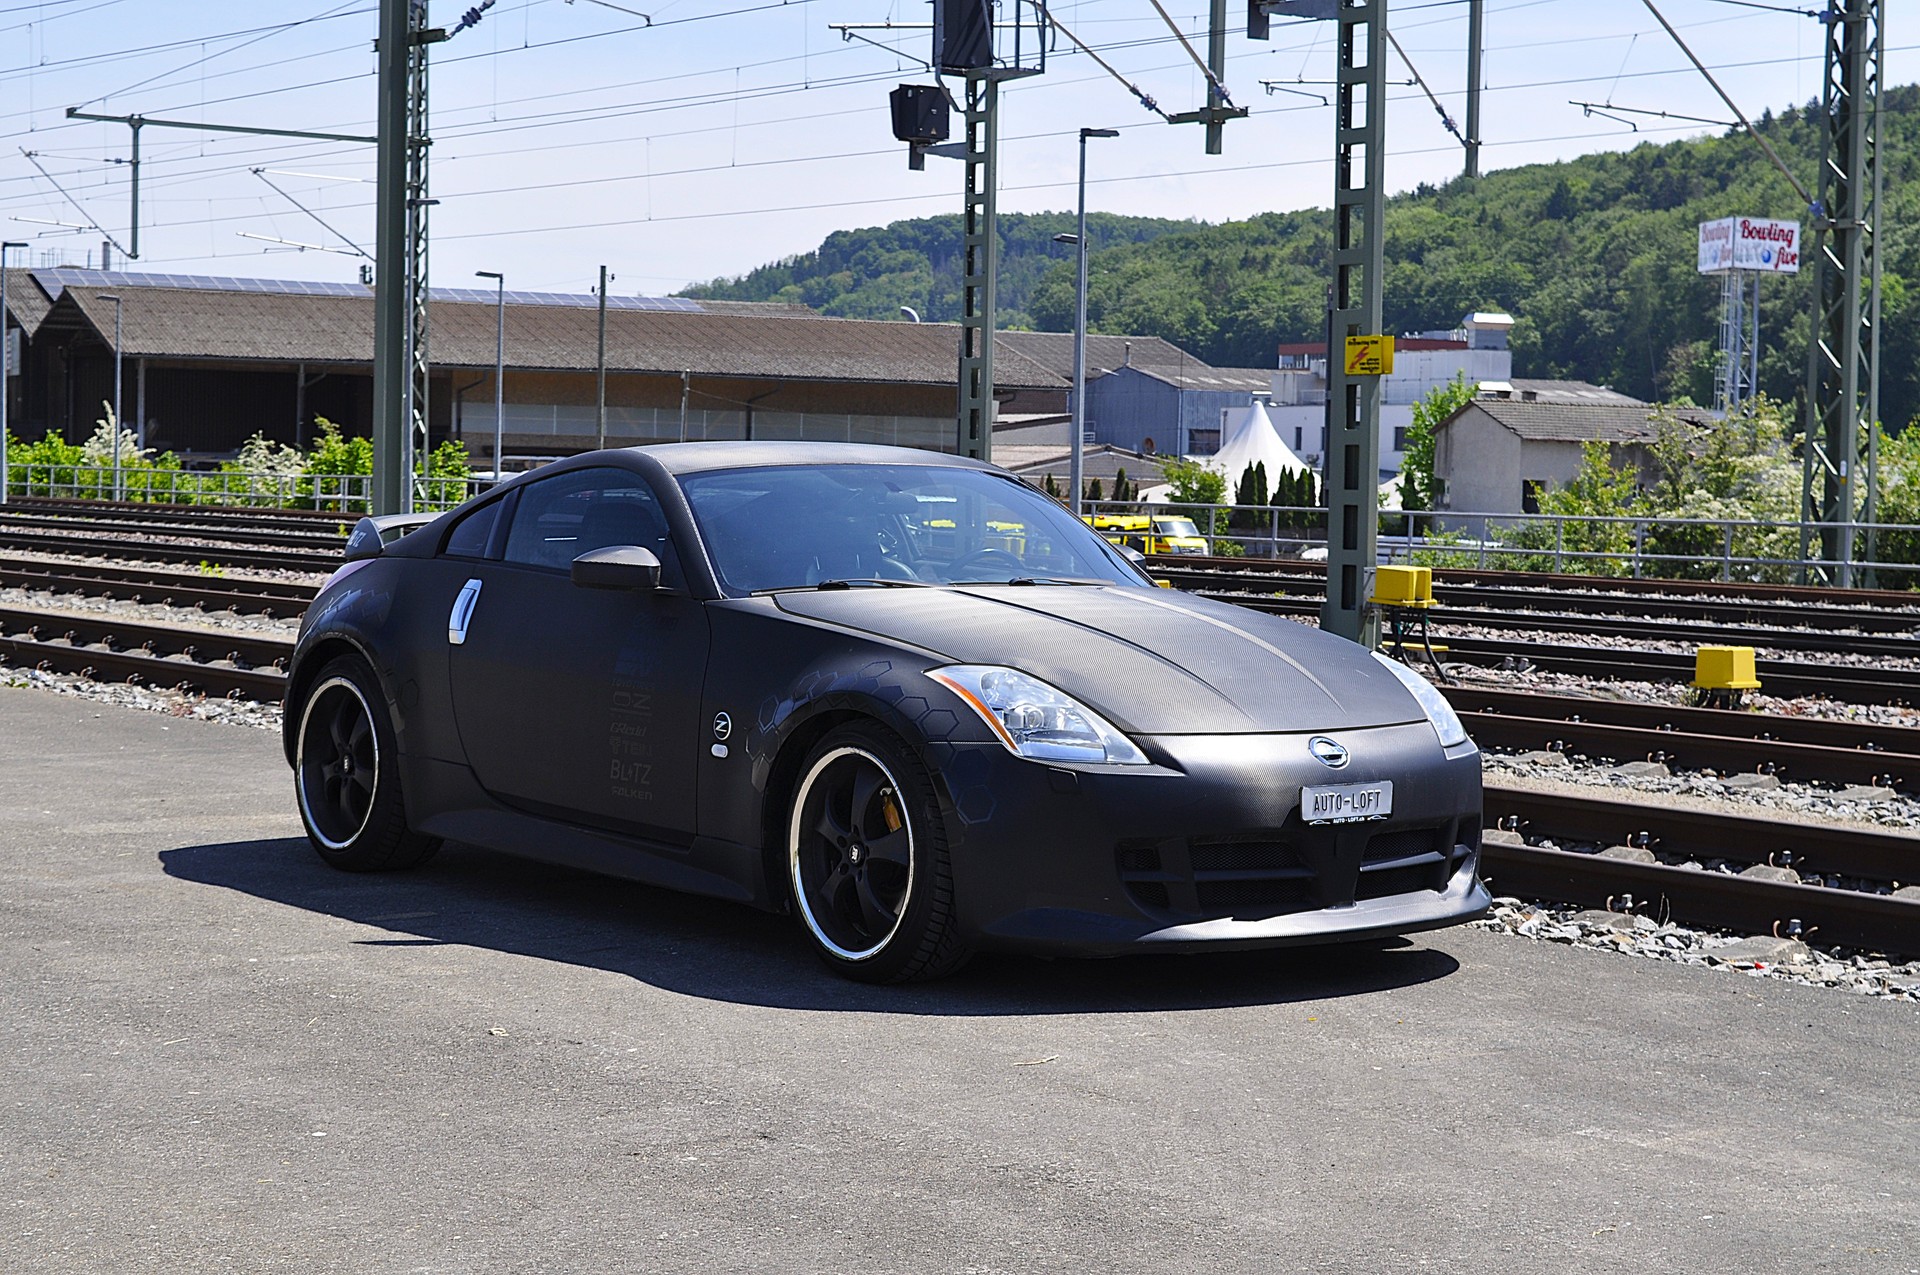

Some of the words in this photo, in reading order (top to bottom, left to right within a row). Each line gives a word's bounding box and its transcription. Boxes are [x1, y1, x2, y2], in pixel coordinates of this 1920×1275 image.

[1702, 222, 1730, 245] Bowling
[1740, 219, 1794, 248] Bowling
[1774, 246, 1798, 269] five
[715, 720, 728, 732] Z
[610, 758, 652, 785] BLITZ
[1314, 790, 1381, 813] AUTO-LOFT
